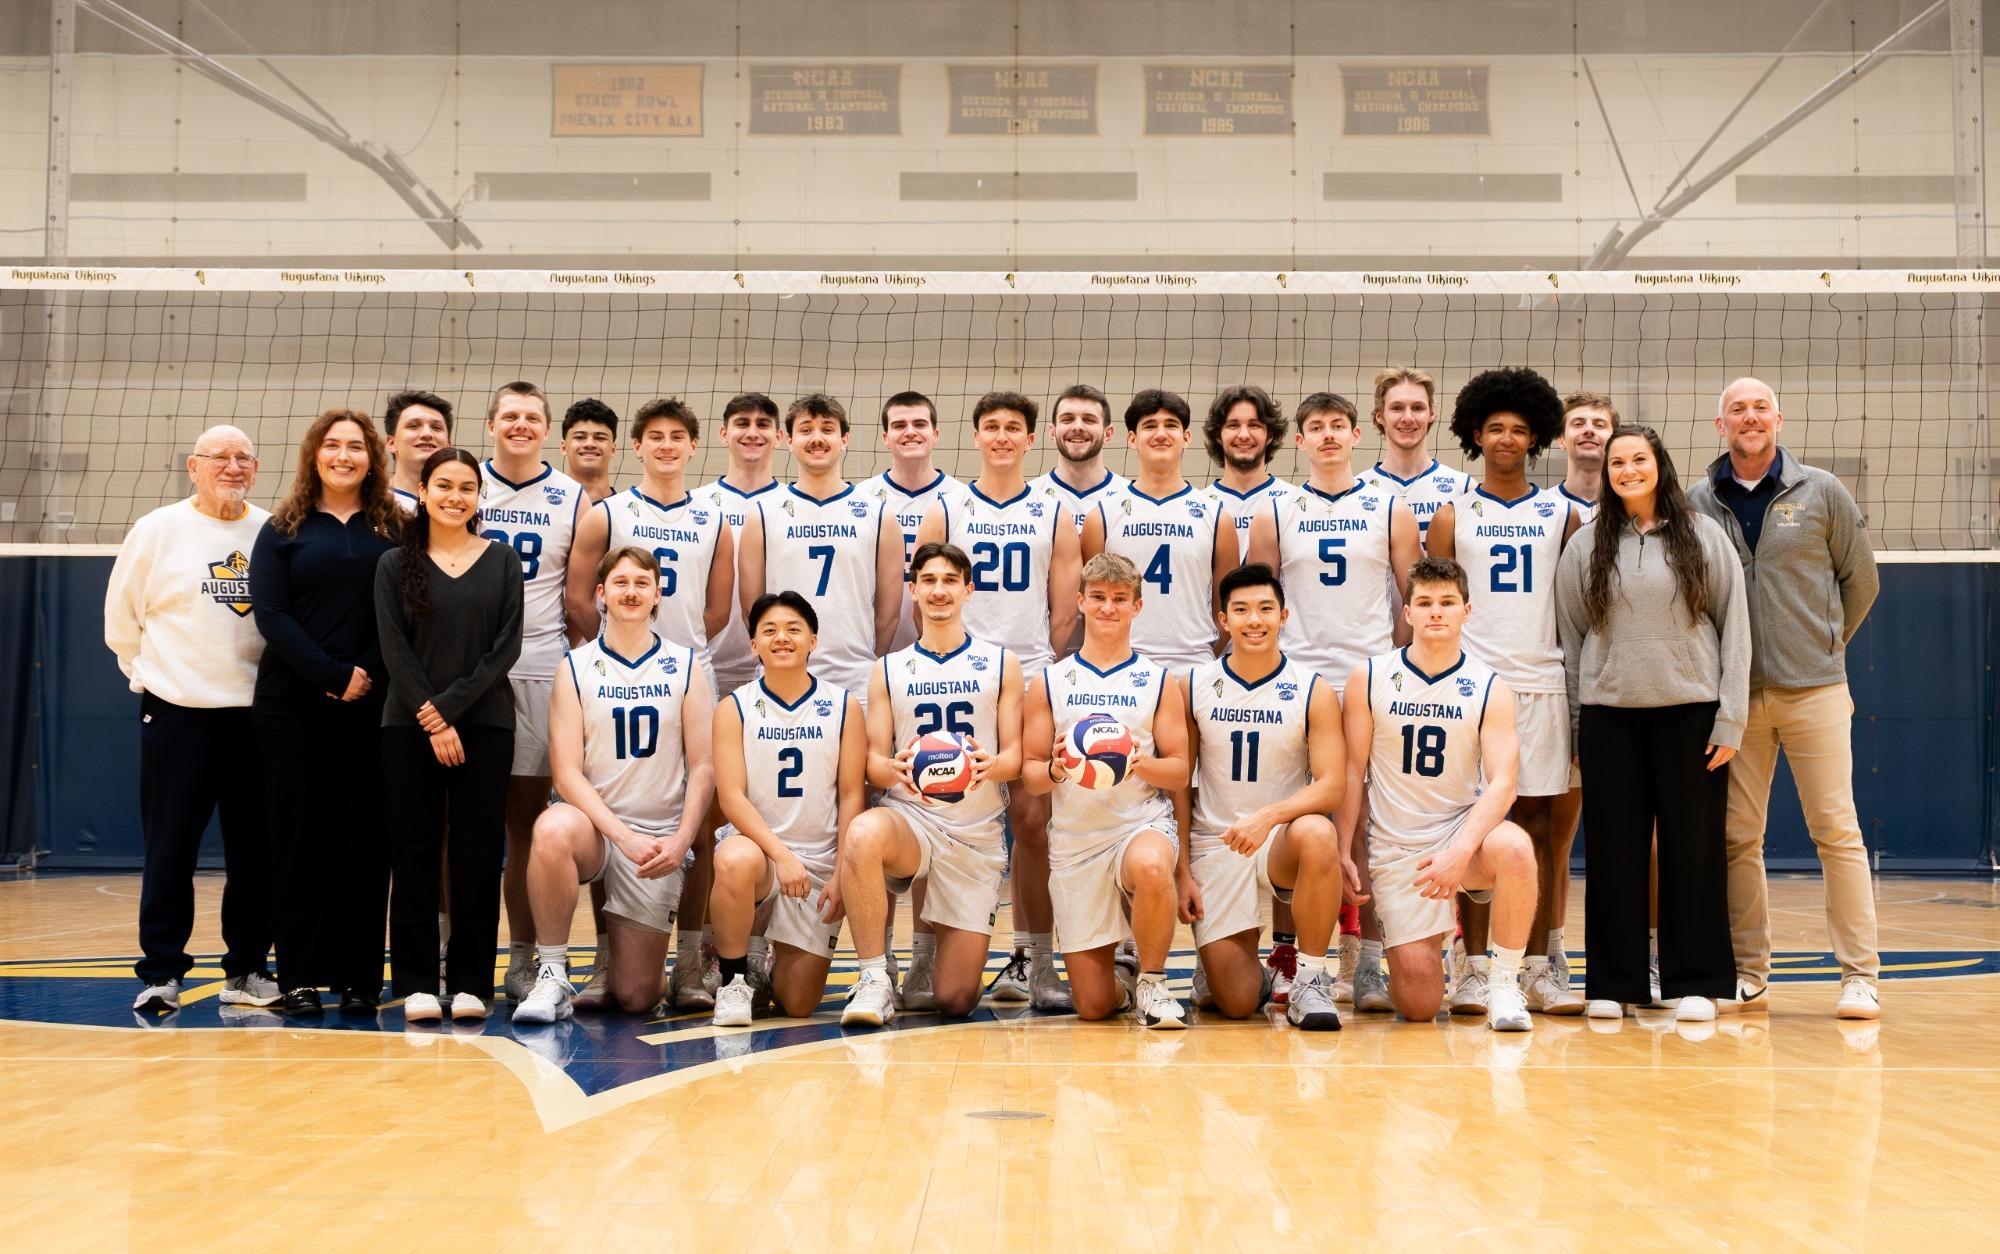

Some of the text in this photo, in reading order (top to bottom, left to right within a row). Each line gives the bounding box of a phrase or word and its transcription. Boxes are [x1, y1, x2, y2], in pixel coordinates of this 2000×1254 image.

[793, 69, 851, 86] NCAA
[995, 71, 1049, 88] NCAA
[1190, 69, 1244, 87] NCAA
[1387, 69, 1440, 86] NCAA
[636, 94, 678, 108] BOWL
[560, 112, 615, 127] PHENIX
[625, 112, 660, 127] CITY
[807, 116, 844, 131] 1983
[1202, 117, 1235, 133] 1985
[12, 269, 117, 284] Augustana Vikings
[281, 271, 386, 286] Augustana Vikings
[549, 273, 656, 288] Augustana Vikings
[820, 274, 926, 288] Augustana Vikings
[1091, 274, 1197, 288] Augustana Vikings
[1363, 274, 1469, 288] Augustana Vikings
[1635, 273, 1741, 287] Augustana Vikings
[1908, 272, 1967, 286] Augustana
[543, 486, 566, 496] NCAA
[1185, 500, 1207, 510] NCAA
[1358, 495, 1379, 503] NCAA
[477, 508, 550, 526] AUGUSTANA
[787, 524, 857, 539] AUGUSTANA
[967, 523, 1036, 536] AUGUSTANA
[1122, 523, 1194, 539] AUGUSTANA
[1298, 519, 1368, 533] AUGUSTANA
[1475, 525, 1545, 538] AUGUSTANA
[633, 525, 699, 543] AUGUSTANA
[972, 541, 1030, 592] 20
[1143, 544, 1173, 594] 4
[1318, 538, 1347, 586] 5
[1490, 544, 1533, 593] 21
[653, 547, 678, 597] 6
[809, 545, 836, 596] 7
[967, 654, 988, 662] NCAA
[598, 684, 671, 700] AUGUSTANA
[907, 679, 981, 697] AUGUSTANA
[1275, 682, 1297, 691] NCAA
[813, 699, 833, 707] NCAA
[1067, 693, 1137, 707] AUGUSTANA
[1210, 707, 1283, 724] AUGUSTANA
[1389, 701, 1463, 720] AUGUSTANA
[914, 701, 974, 737] 26
[612, 705, 659, 759] 10
[757, 726, 823, 741] AUGUSTANA
[1092, 726, 1119, 734] NCAA
[1230, 730, 1260, 782] 11
[1401, 724, 1447, 778] 18
[777, 747, 803, 798] 2
[928, 767, 955, 776] NCAA
